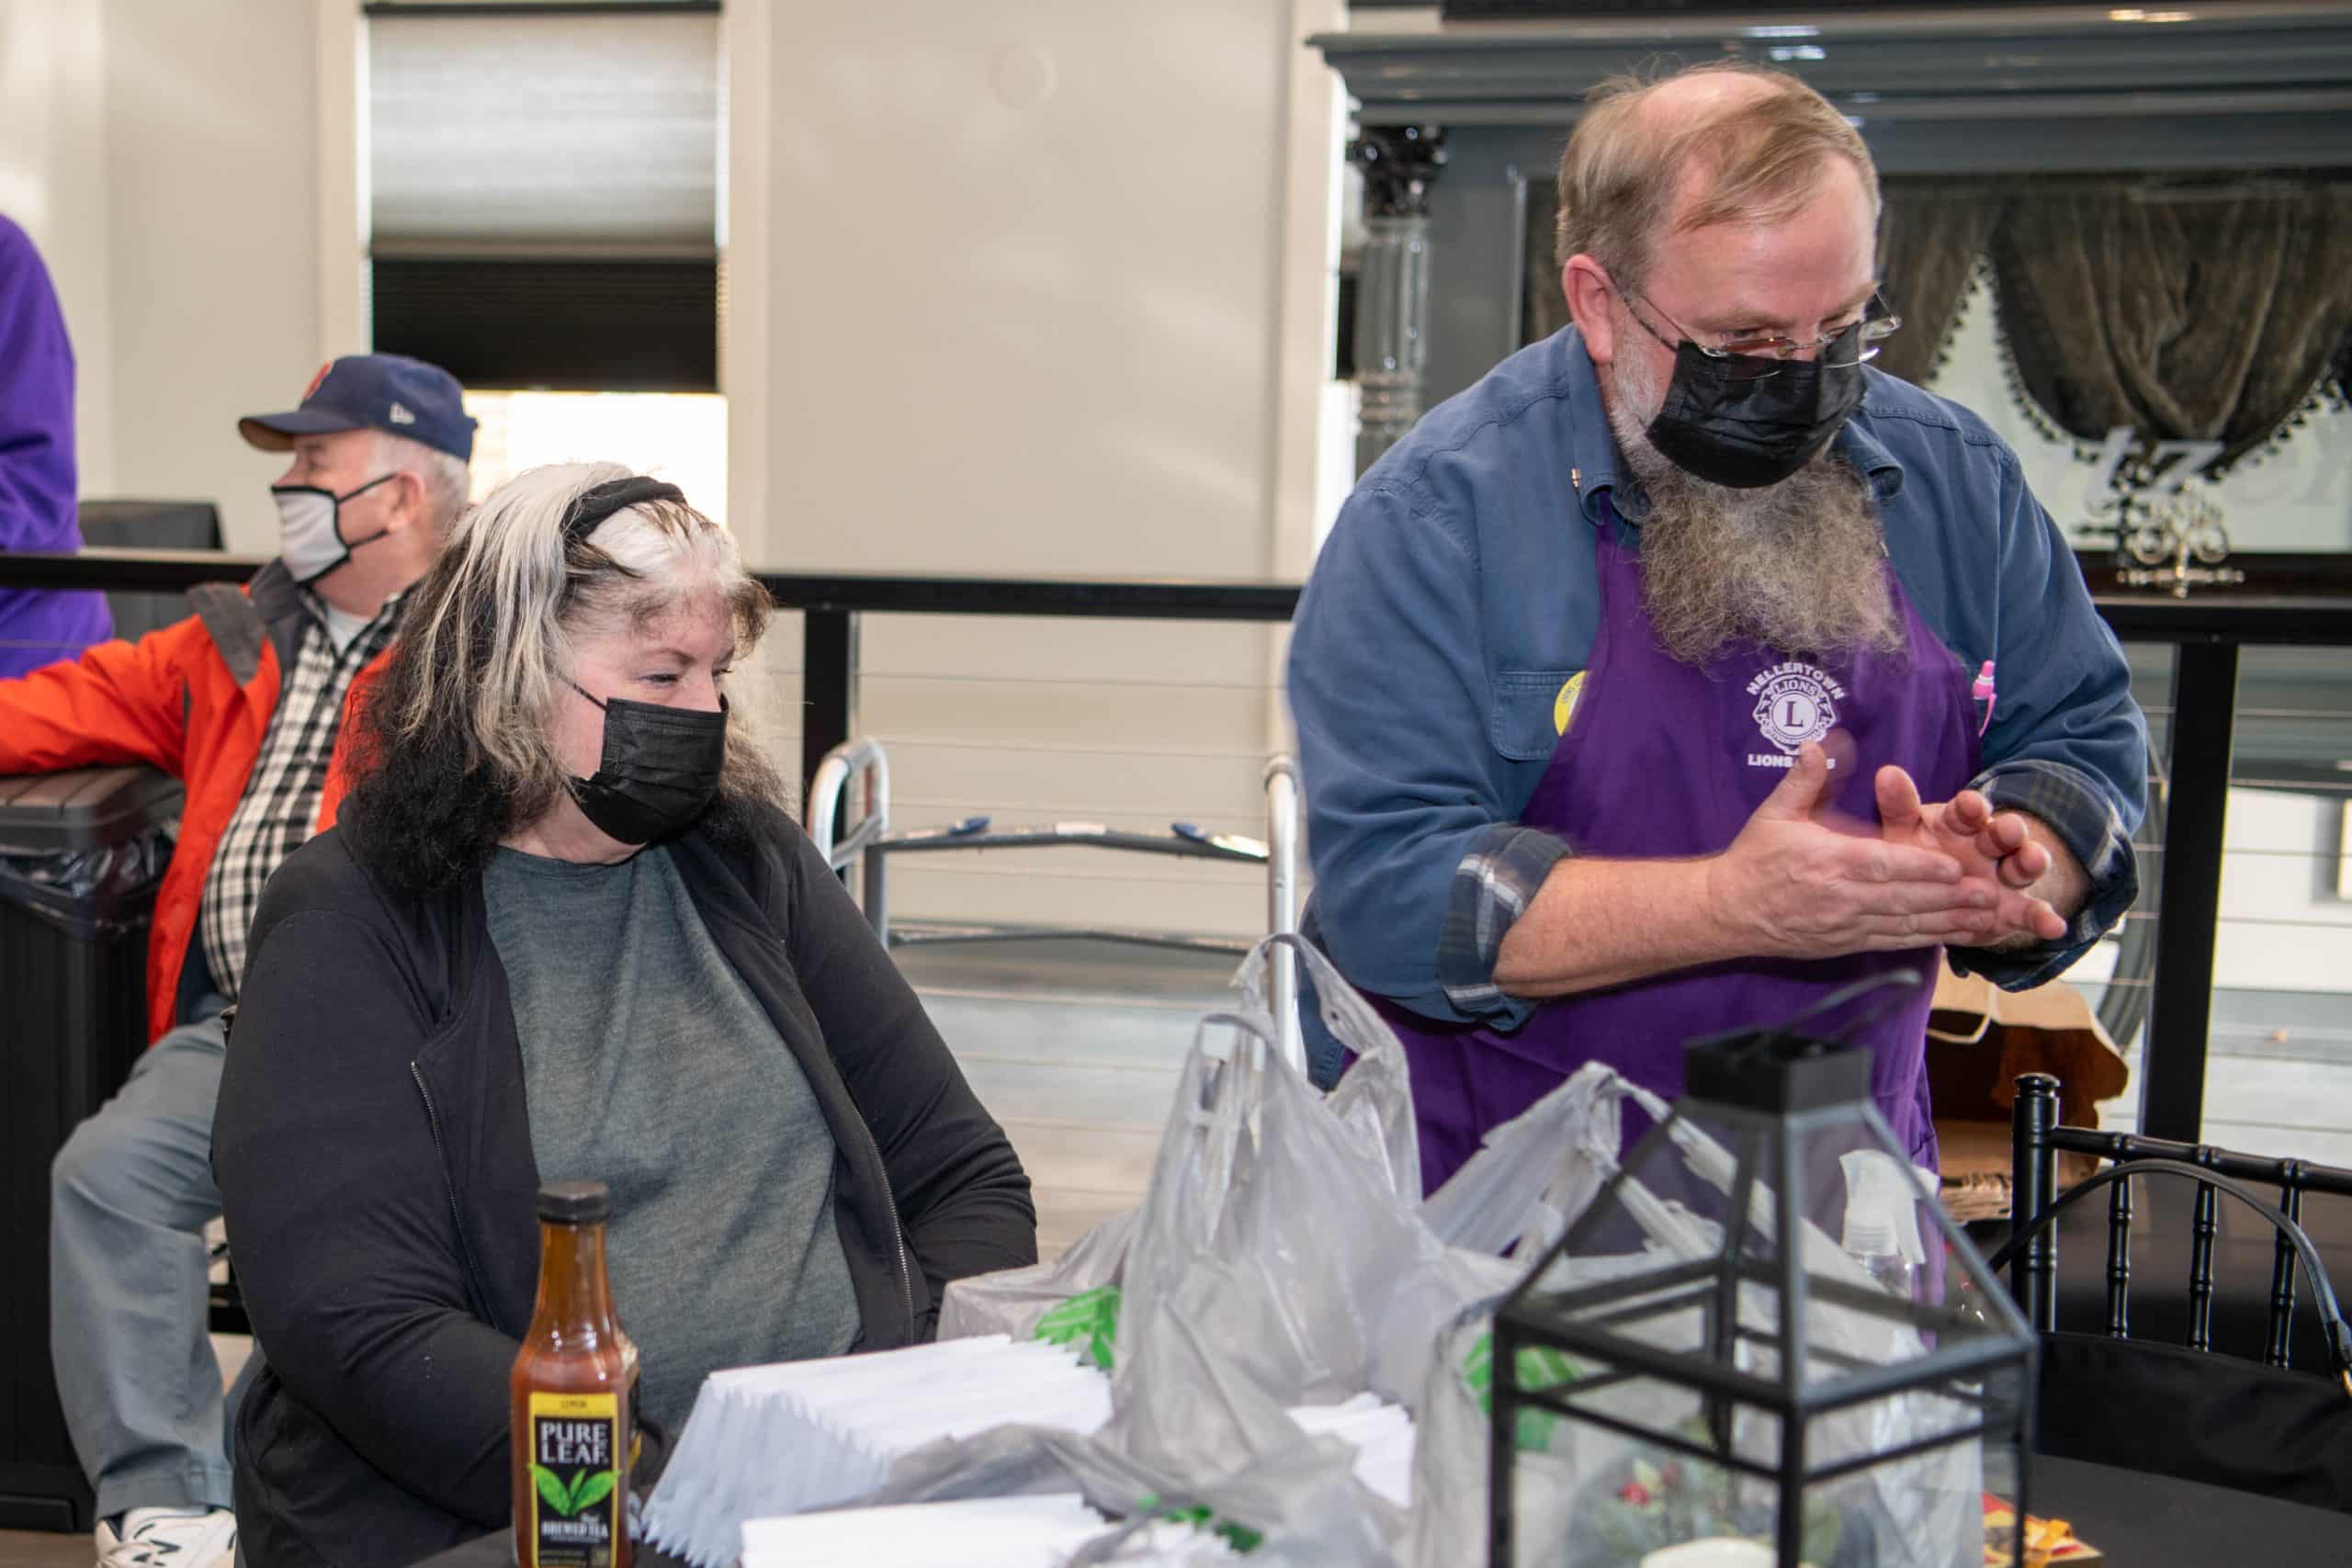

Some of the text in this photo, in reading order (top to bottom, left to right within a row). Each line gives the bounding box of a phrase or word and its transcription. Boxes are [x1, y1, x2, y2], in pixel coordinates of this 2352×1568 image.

[1747, 662, 1845, 699] HELLERTOWN
[1774, 679, 1817, 696] LIONS
[1783, 701, 1804, 728] L
[1747, 753, 1792, 768] LIONS
[540, 1422, 608, 1443] PURE
[541, 1442, 608, 1465] LEAF
